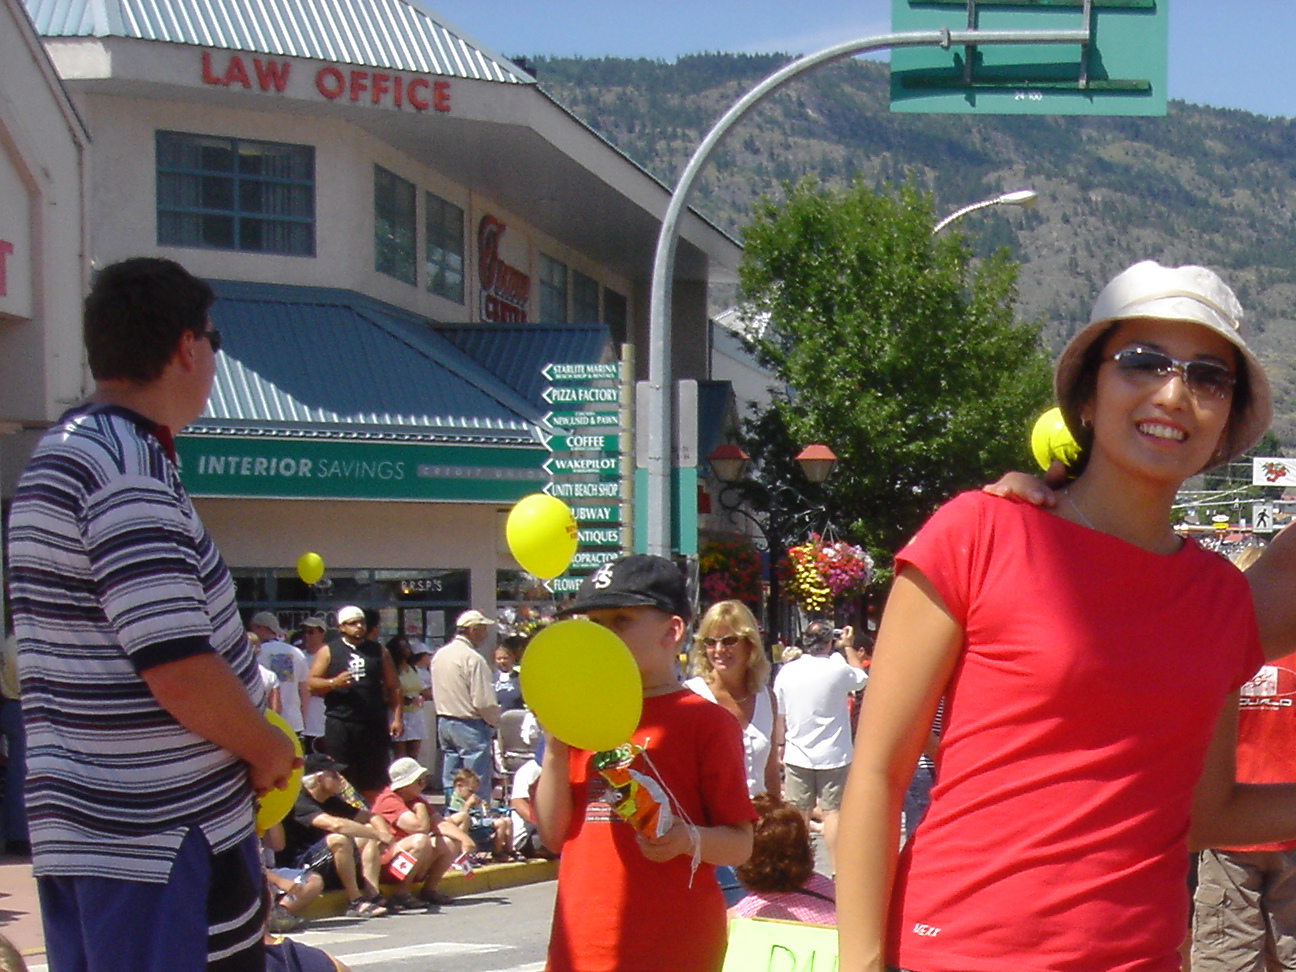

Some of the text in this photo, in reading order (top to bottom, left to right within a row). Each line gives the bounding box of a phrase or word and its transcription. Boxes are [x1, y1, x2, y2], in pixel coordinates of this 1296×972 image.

[202, 51, 452, 112] LAW OFFICE
[586, 364, 617, 374] MARINA
[552, 389, 617, 401] PIZZA FACTORY
[566, 436, 605, 447] COFFEE
[198, 455, 313, 478] INTERIOR
[317, 458, 405, 481] SAVINGS
[555, 459, 617, 469] WAKEPILOT
[552, 483, 618, 496] UNITY BEACH SHOP
[571, 507, 611, 519] UBWAY
[577, 530, 618, 544] NTIQUES
